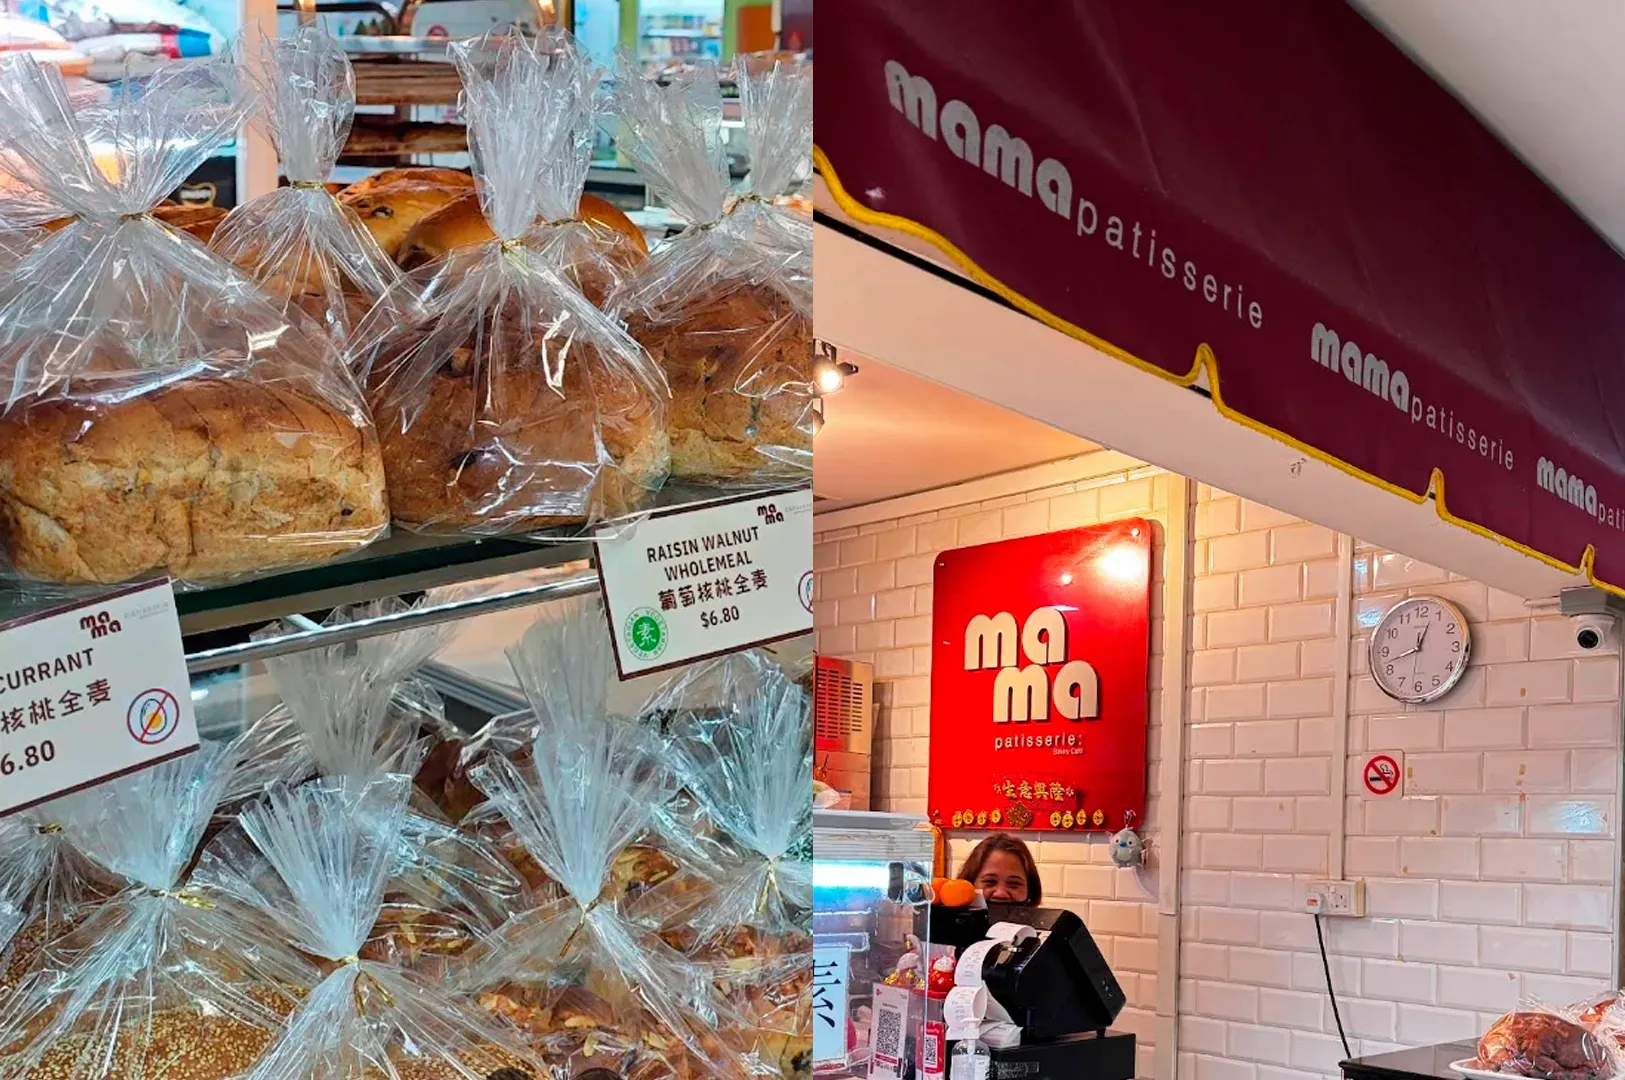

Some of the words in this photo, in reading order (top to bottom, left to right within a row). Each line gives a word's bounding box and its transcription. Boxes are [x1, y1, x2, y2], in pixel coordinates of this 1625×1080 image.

[884, 60, 1072, 220] mama
[1077, 199, 1262, 329] patisserie
[1311, 322, 1409, 412] mama
[1411, 396, 1513, 470] patisserie
[1537, 456, 1597, 517] mama
[647, 540, 699, 563] RAISIN
[702, 526, 760, 552] WALNUT
[665, 551, 753, 582] WHOLEMEAL
[658, 569, 768, 612] 葡萄核桃全麦
[80, 611, 110, 630] ma
[700, 605, 740, 629] $6.80
[1400, 612, 1411, 624] 11
[1414, 606, 1428, 618] 12
[1436, 610, 1442, 621] 1
[91, 620, 122, 639] ma
[965, 606, 1065, 670] ma
[1387, 628, 1398, 640] 10
[1446, 623, 1455, 634] 2
[1381, 646, 1390, 658] 9
[1452, 640, 1460, 652] 3
[1386, 664, 1394, 676] 8
[1445, 661, 1454, 672] 4
[1398, 676, 1406, 688] 7
[1414, 681, 1422, 692] 6
[1432, 674, 1440, 686] 5
[993, 660, 1098, 722] ma
[1, 678, 111, 734] 核桃全麦
[0, 740, 56, 776] 6.80
